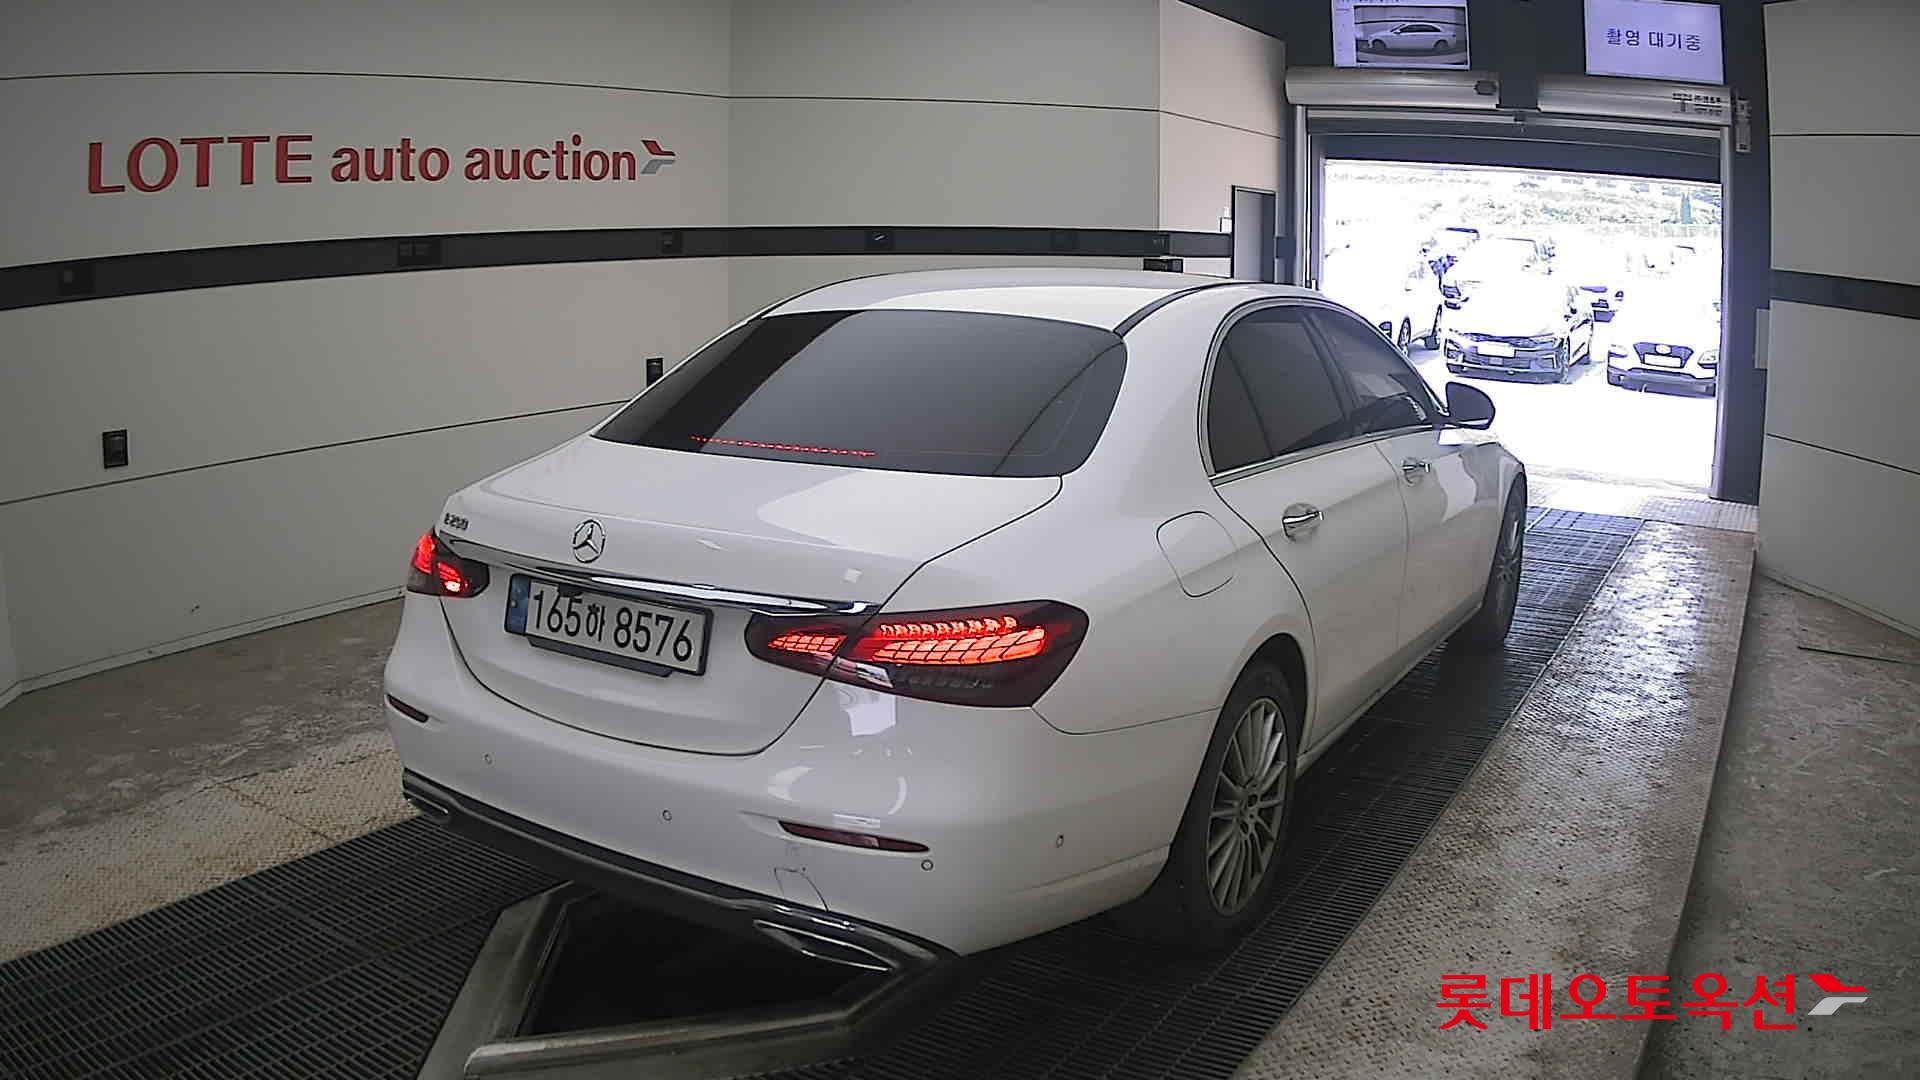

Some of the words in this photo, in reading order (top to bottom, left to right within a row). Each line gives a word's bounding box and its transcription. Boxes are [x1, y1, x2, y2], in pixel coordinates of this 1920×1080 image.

[1607, 28, 1640, 47] 촬영
[1648, 31, 1702, 52] 대기중
[90, 135, 311, 193] LOTTE
[332, 138, 451, 182] auto
[463, 134, 638, 182] auction
[533, 588, 607, 642] 165하
[613, 605, 694, 662] 8576
